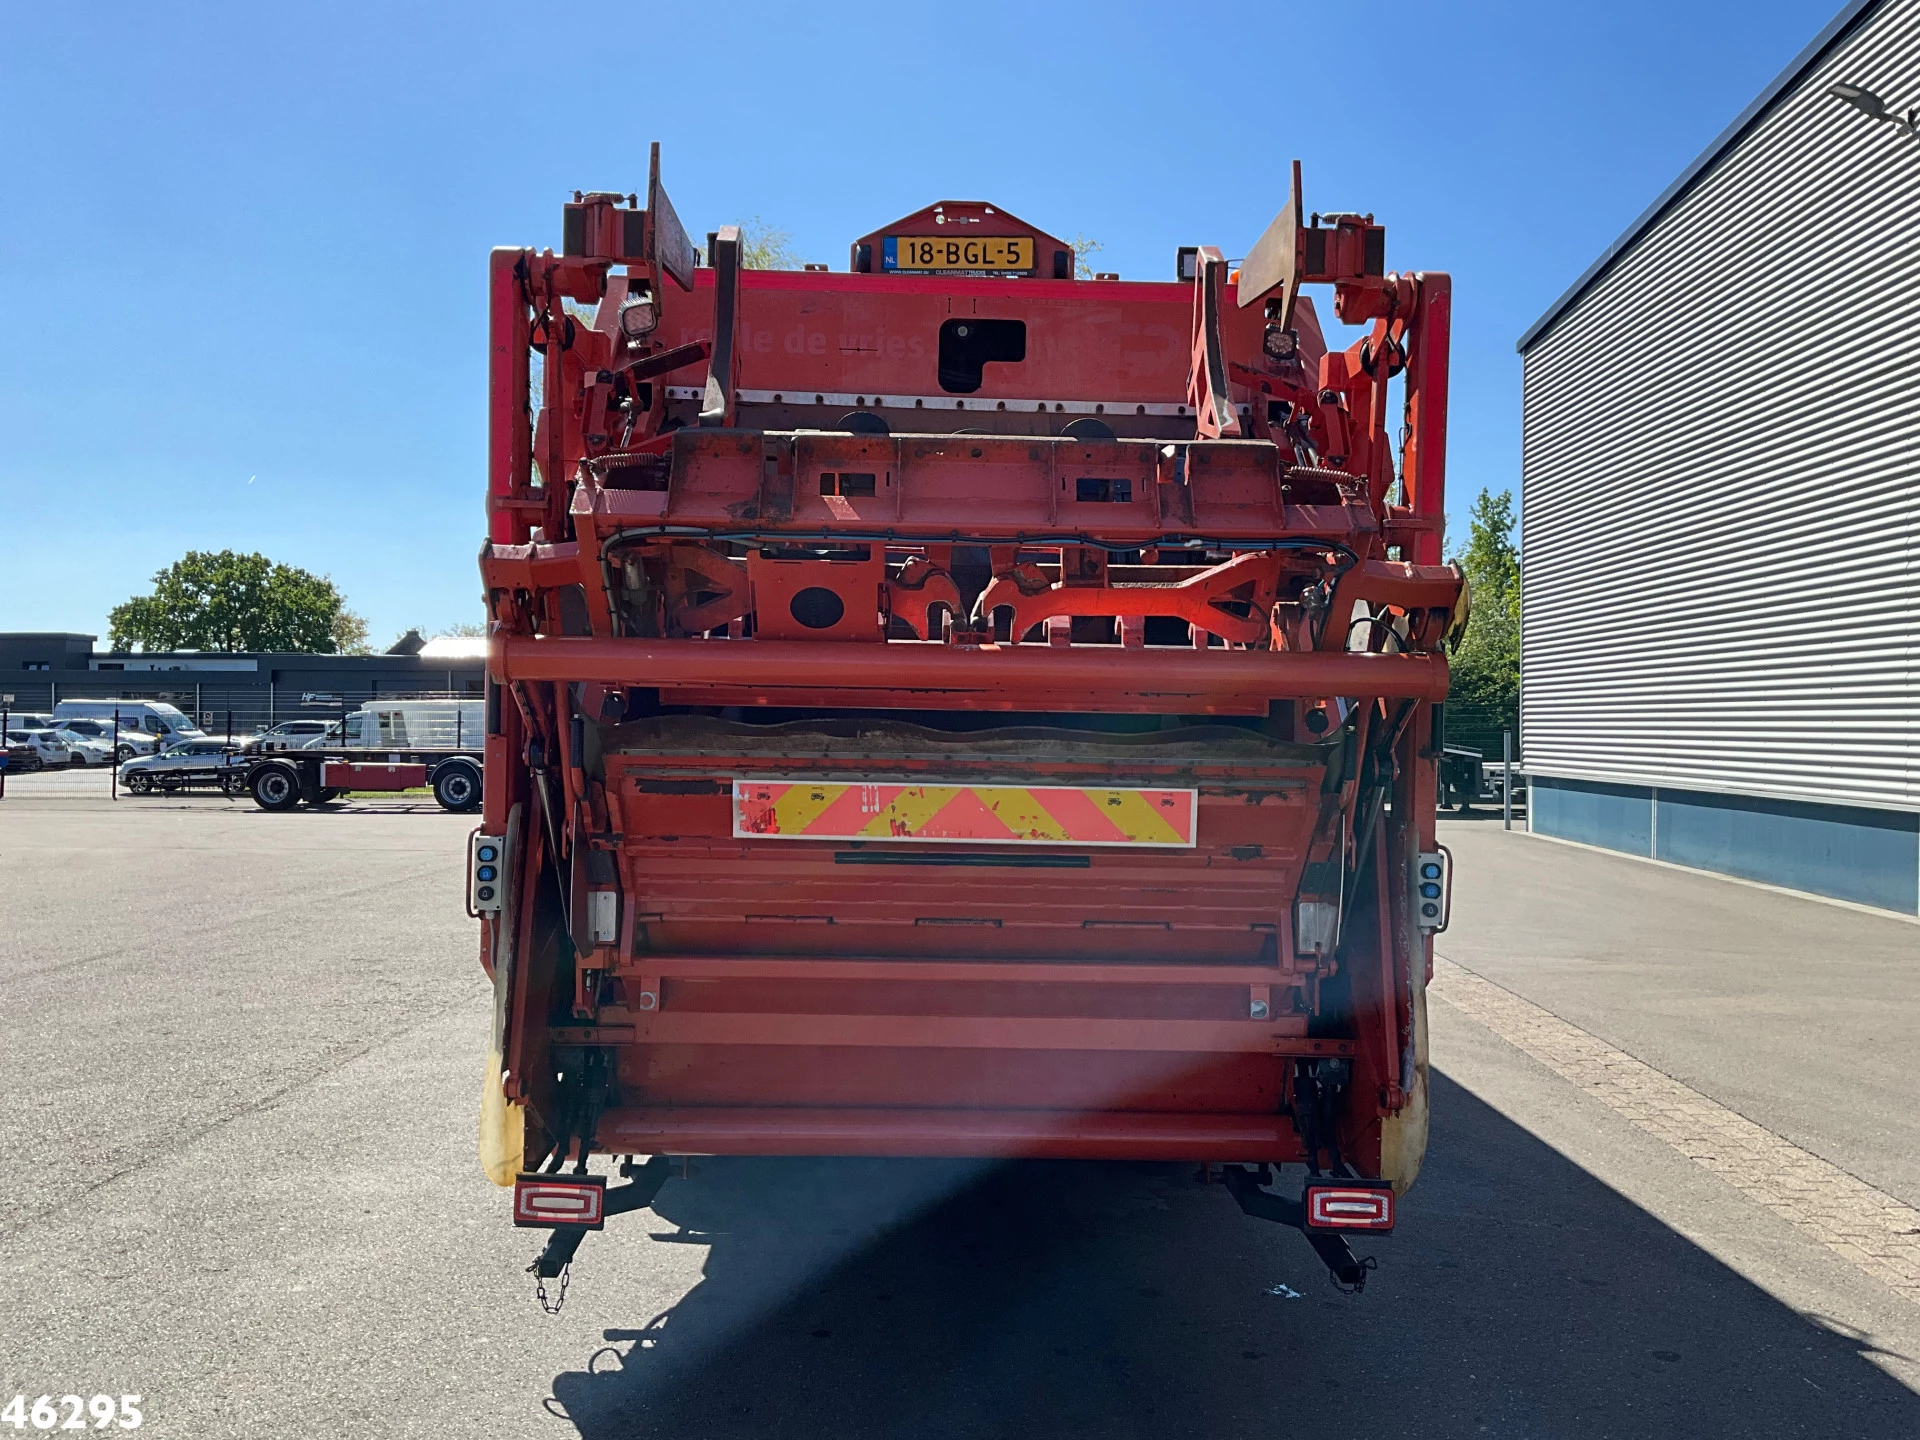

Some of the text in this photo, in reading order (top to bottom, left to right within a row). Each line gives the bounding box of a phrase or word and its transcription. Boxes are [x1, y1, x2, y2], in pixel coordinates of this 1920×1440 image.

[885, 256, 895, 264] NL
[909, 242, 1020, 264] 18-BGL-5
[784, 324, 827, 355] de
[838, 327, 925, 358] vries
